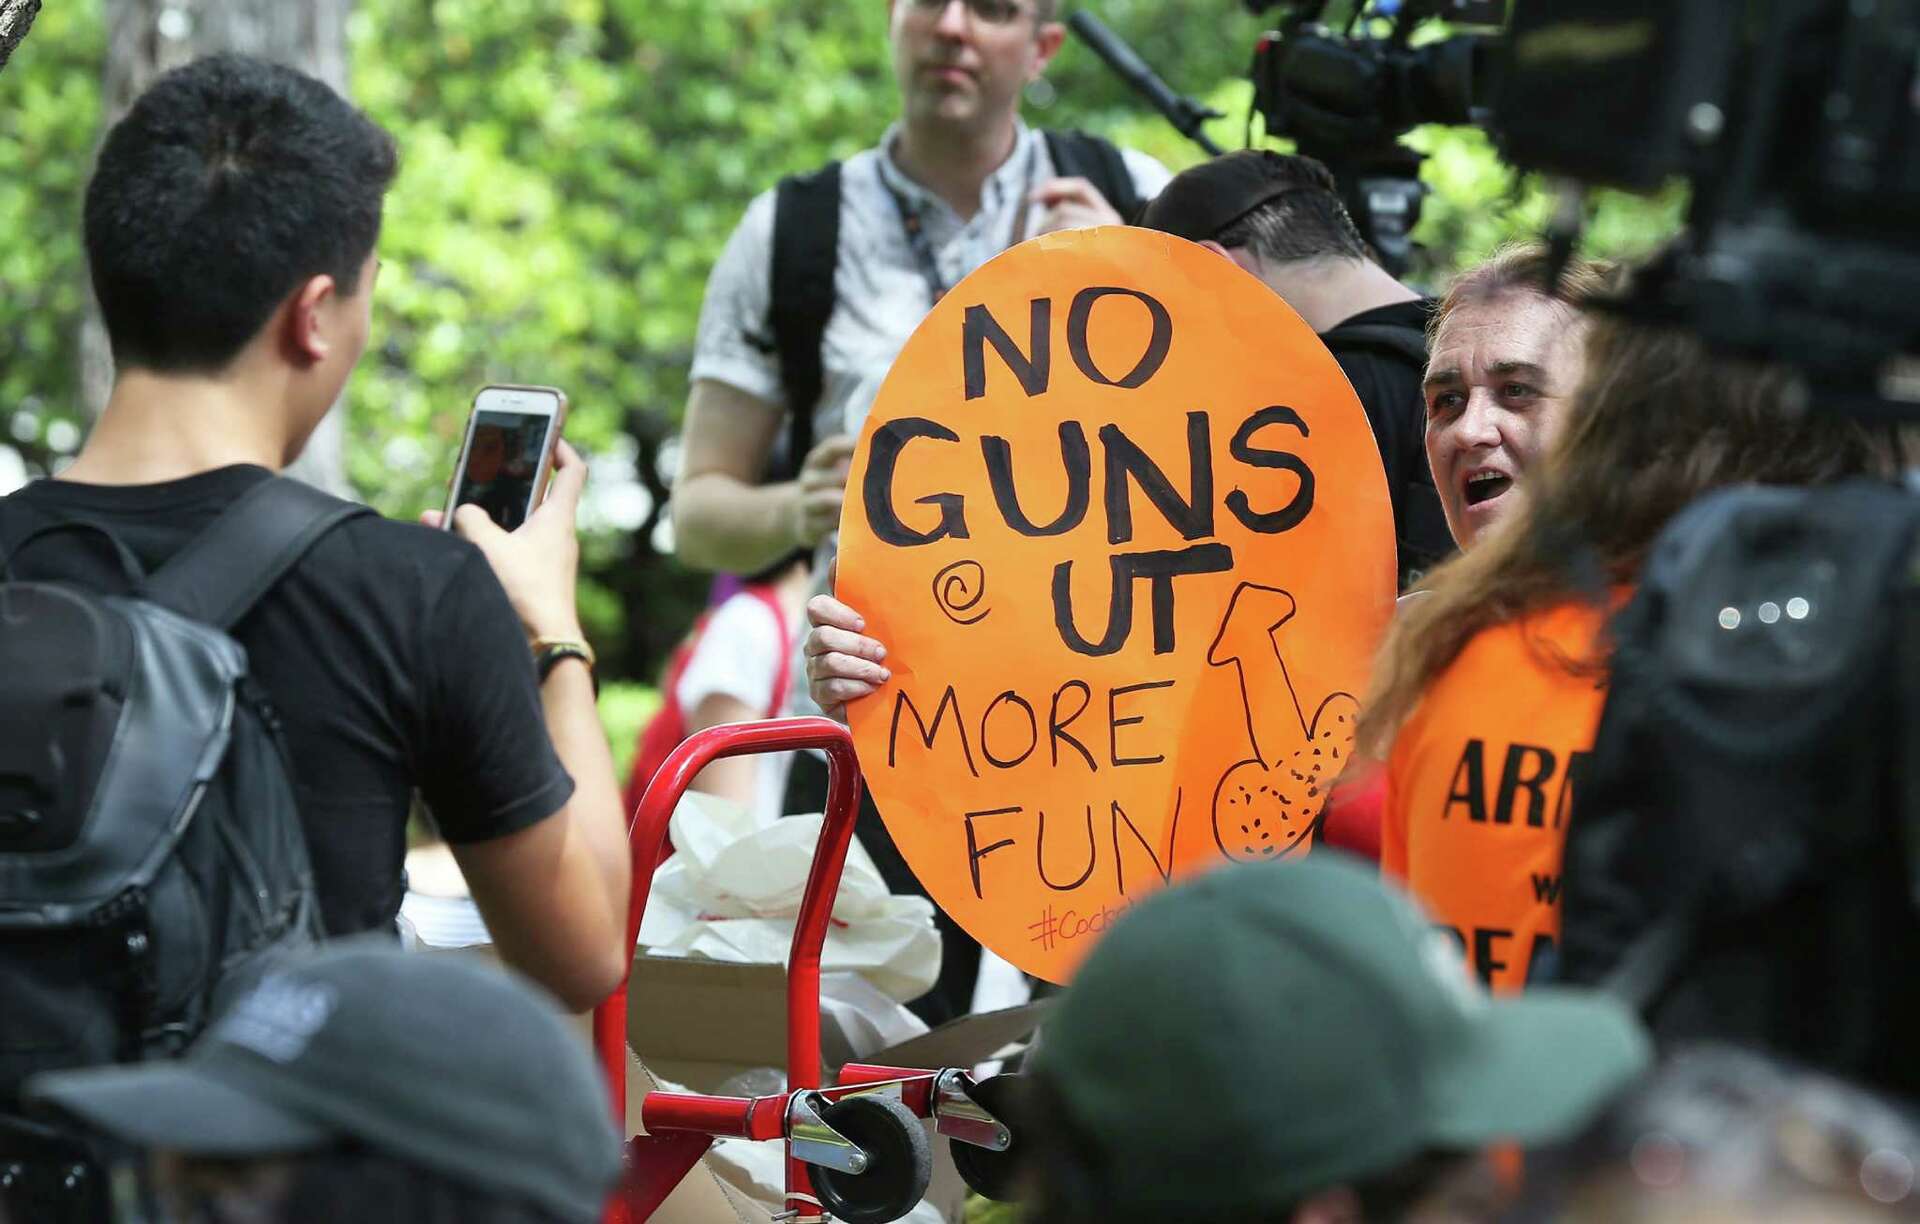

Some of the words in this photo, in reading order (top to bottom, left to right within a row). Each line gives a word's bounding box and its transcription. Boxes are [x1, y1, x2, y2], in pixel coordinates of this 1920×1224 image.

[962, 286, 1173, 401] NO
[862, 404, 1315, 547] GUNS
[888, 679, 1176, 777] MORE
[964, 786, 1182, 899] FUN
